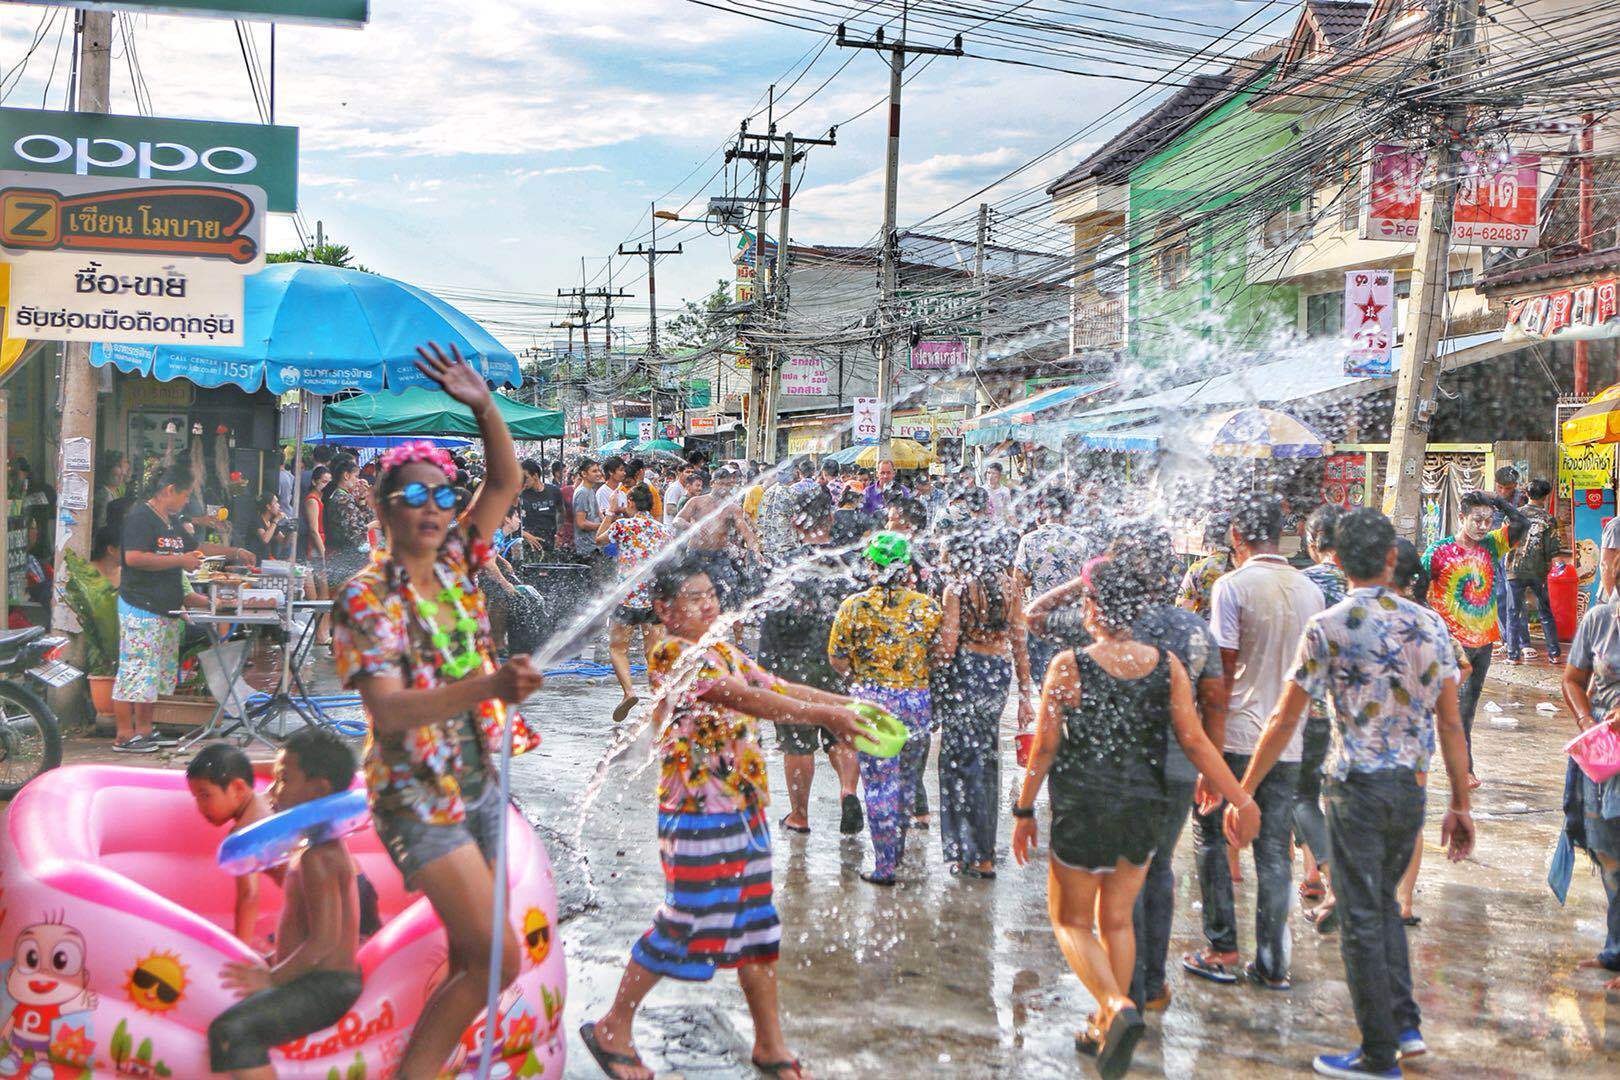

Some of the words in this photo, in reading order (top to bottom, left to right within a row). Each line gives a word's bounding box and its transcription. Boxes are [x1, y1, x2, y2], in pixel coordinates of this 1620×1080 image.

[137, 204, 221, 239] โมบาย
[1395, 224, 1419, 236] PE
[190, 357, 218, 365] CENTER
[223, 361, 254, 380] 1551
[858, 424, 876, 433] CTS
